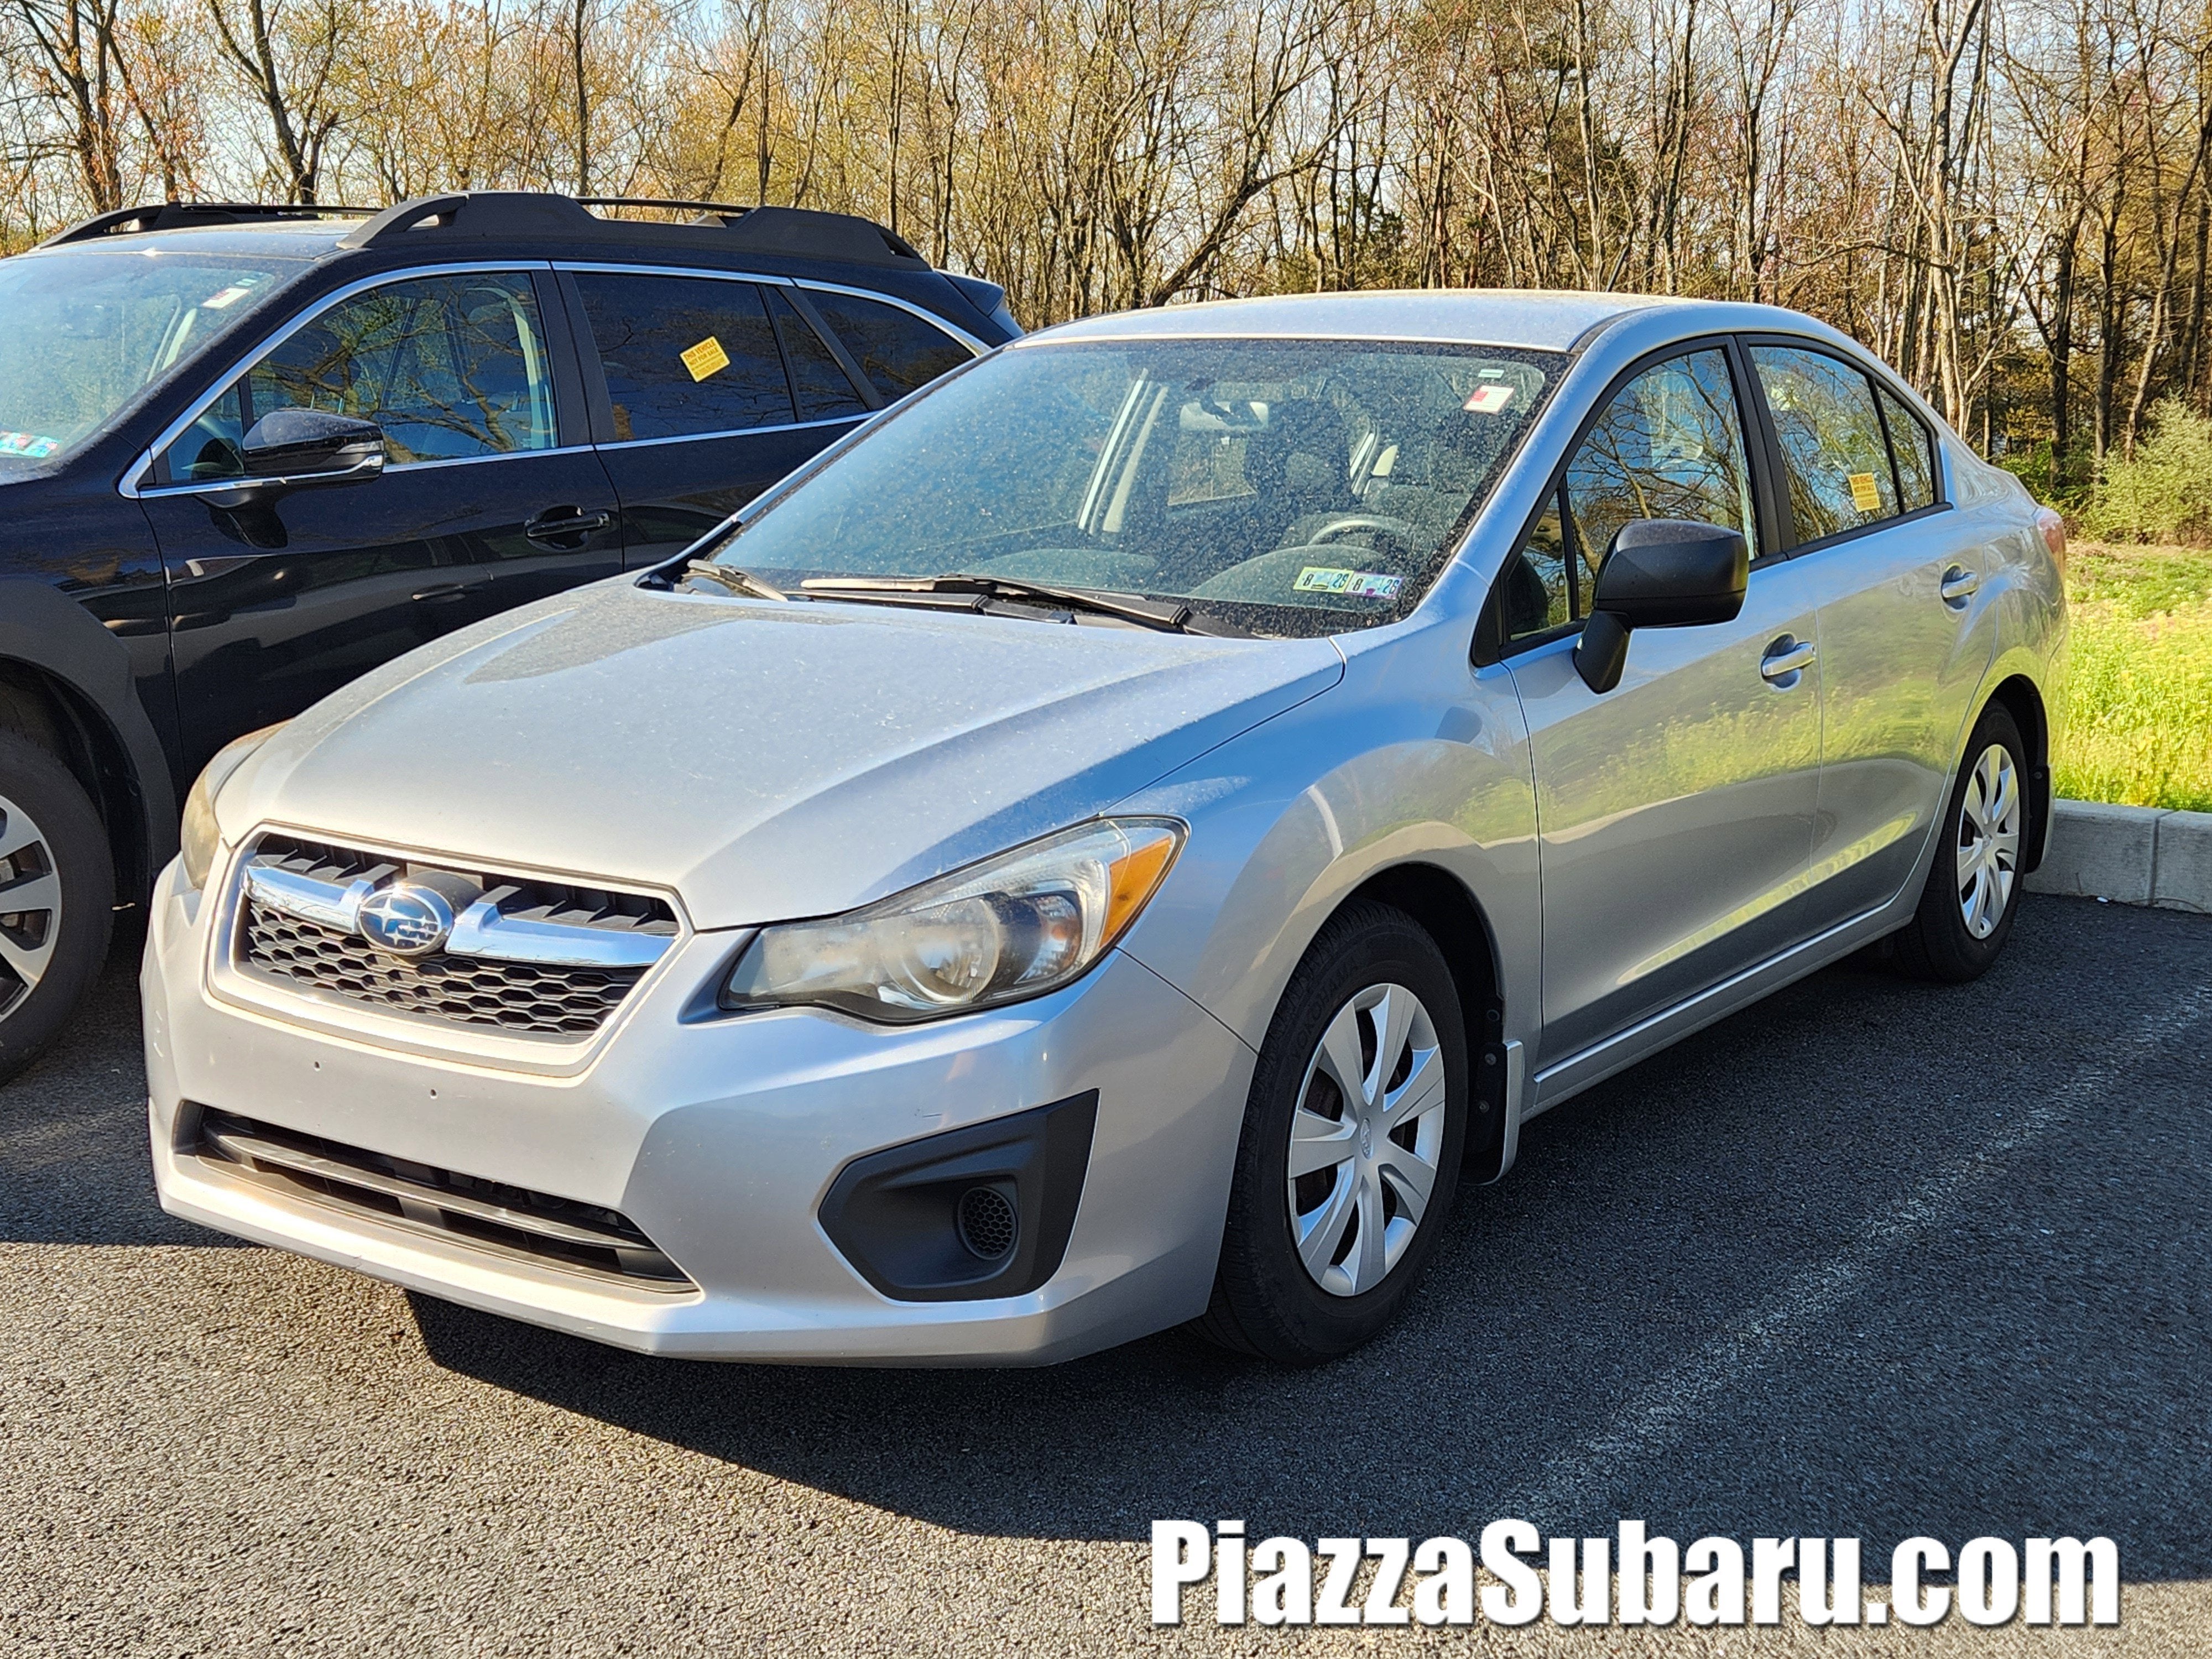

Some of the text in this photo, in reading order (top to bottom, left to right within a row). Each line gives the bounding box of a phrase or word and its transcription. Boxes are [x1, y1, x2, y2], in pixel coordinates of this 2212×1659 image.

[1303, 573, 1314, 586] 8
[1352, 578, 1364, 591] 8
[1286, 956, 1359, 1061] YOKOHAMA
